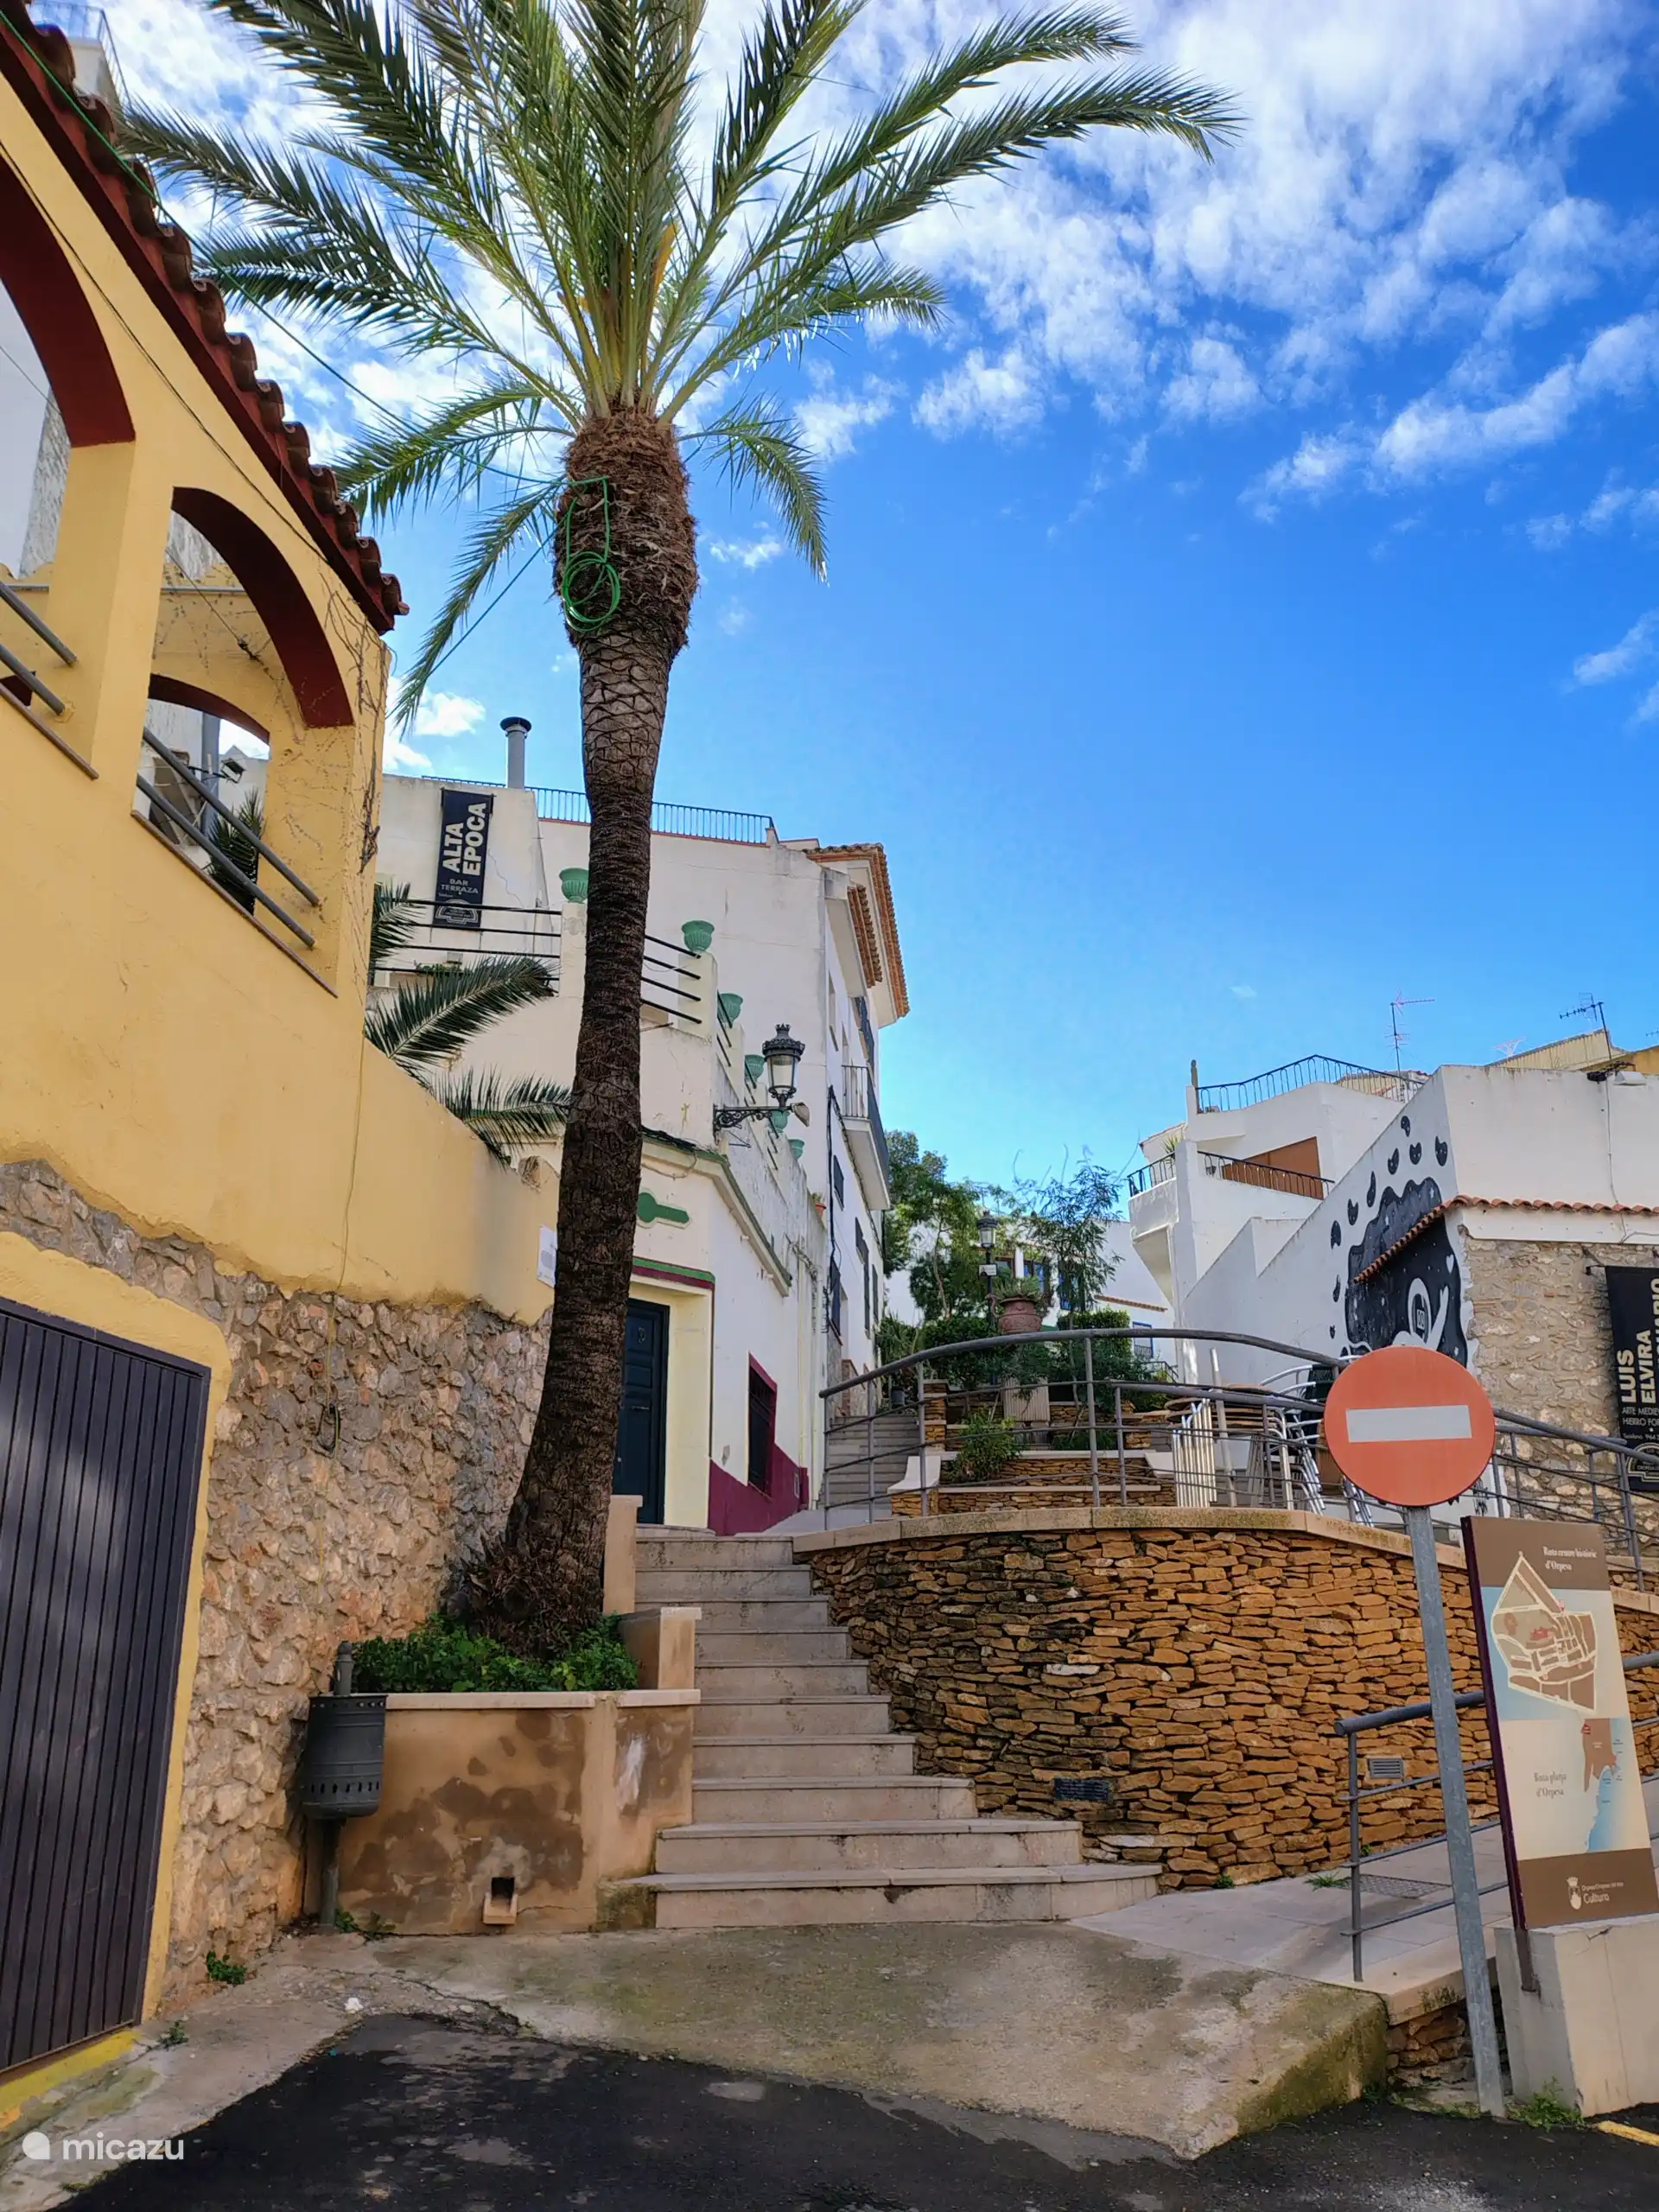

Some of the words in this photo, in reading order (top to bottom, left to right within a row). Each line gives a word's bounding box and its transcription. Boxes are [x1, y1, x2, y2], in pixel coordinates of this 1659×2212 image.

[442, 822, 464, 874] ALTA
[462, 803, 486, 876] EPOCA
[441, 884, 479, 894] TERRAZA
[1617, 1350, 1637, 1403] LUIS
[1636, 1330, 1656, 1404] ELVIRA
[1622, 1406, 1637, 1415] ARTE
[1583, 1892, 1610, 1904] Cultura
